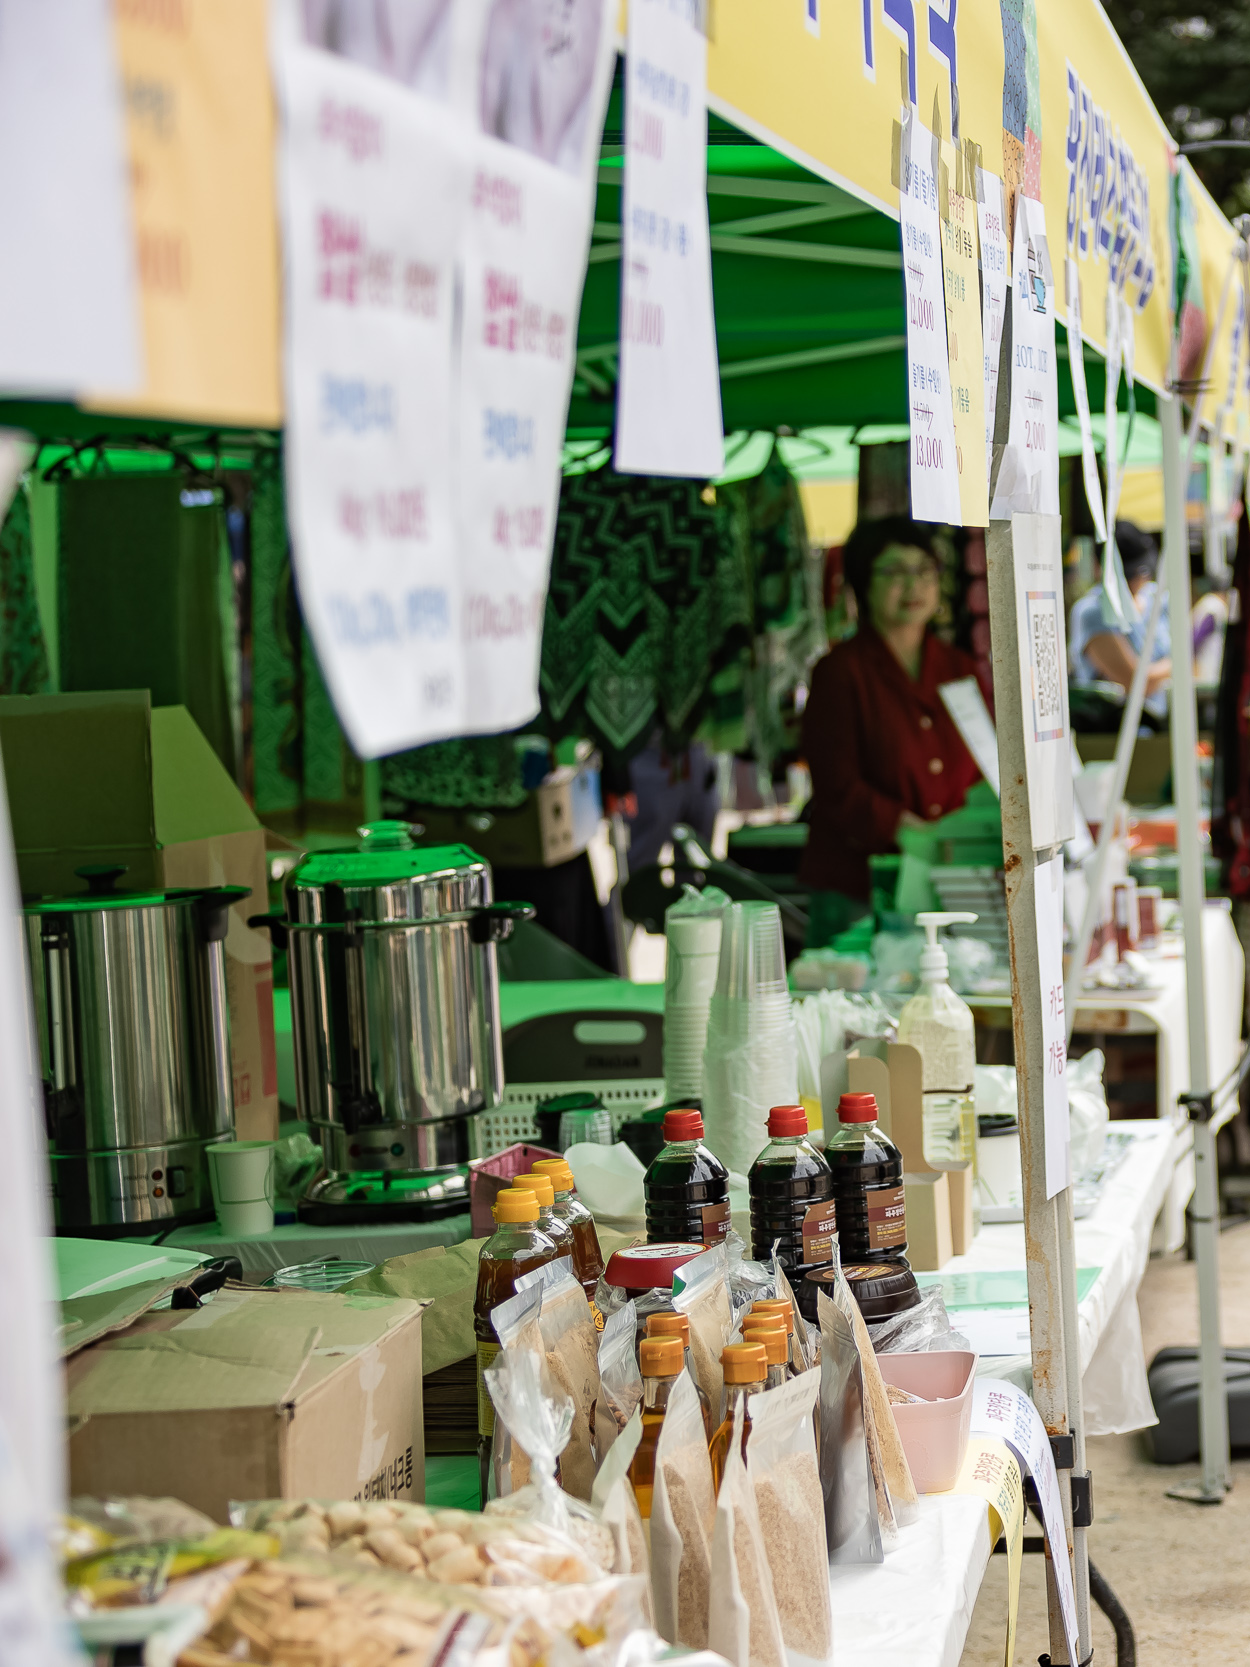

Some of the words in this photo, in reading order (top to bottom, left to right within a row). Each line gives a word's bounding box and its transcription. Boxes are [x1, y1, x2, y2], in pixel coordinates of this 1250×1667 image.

[909, 292, 935, 332] 12,000
[915, 434, 944, 471] 13,000
[1025, 420, 1046, 452] 2,000
